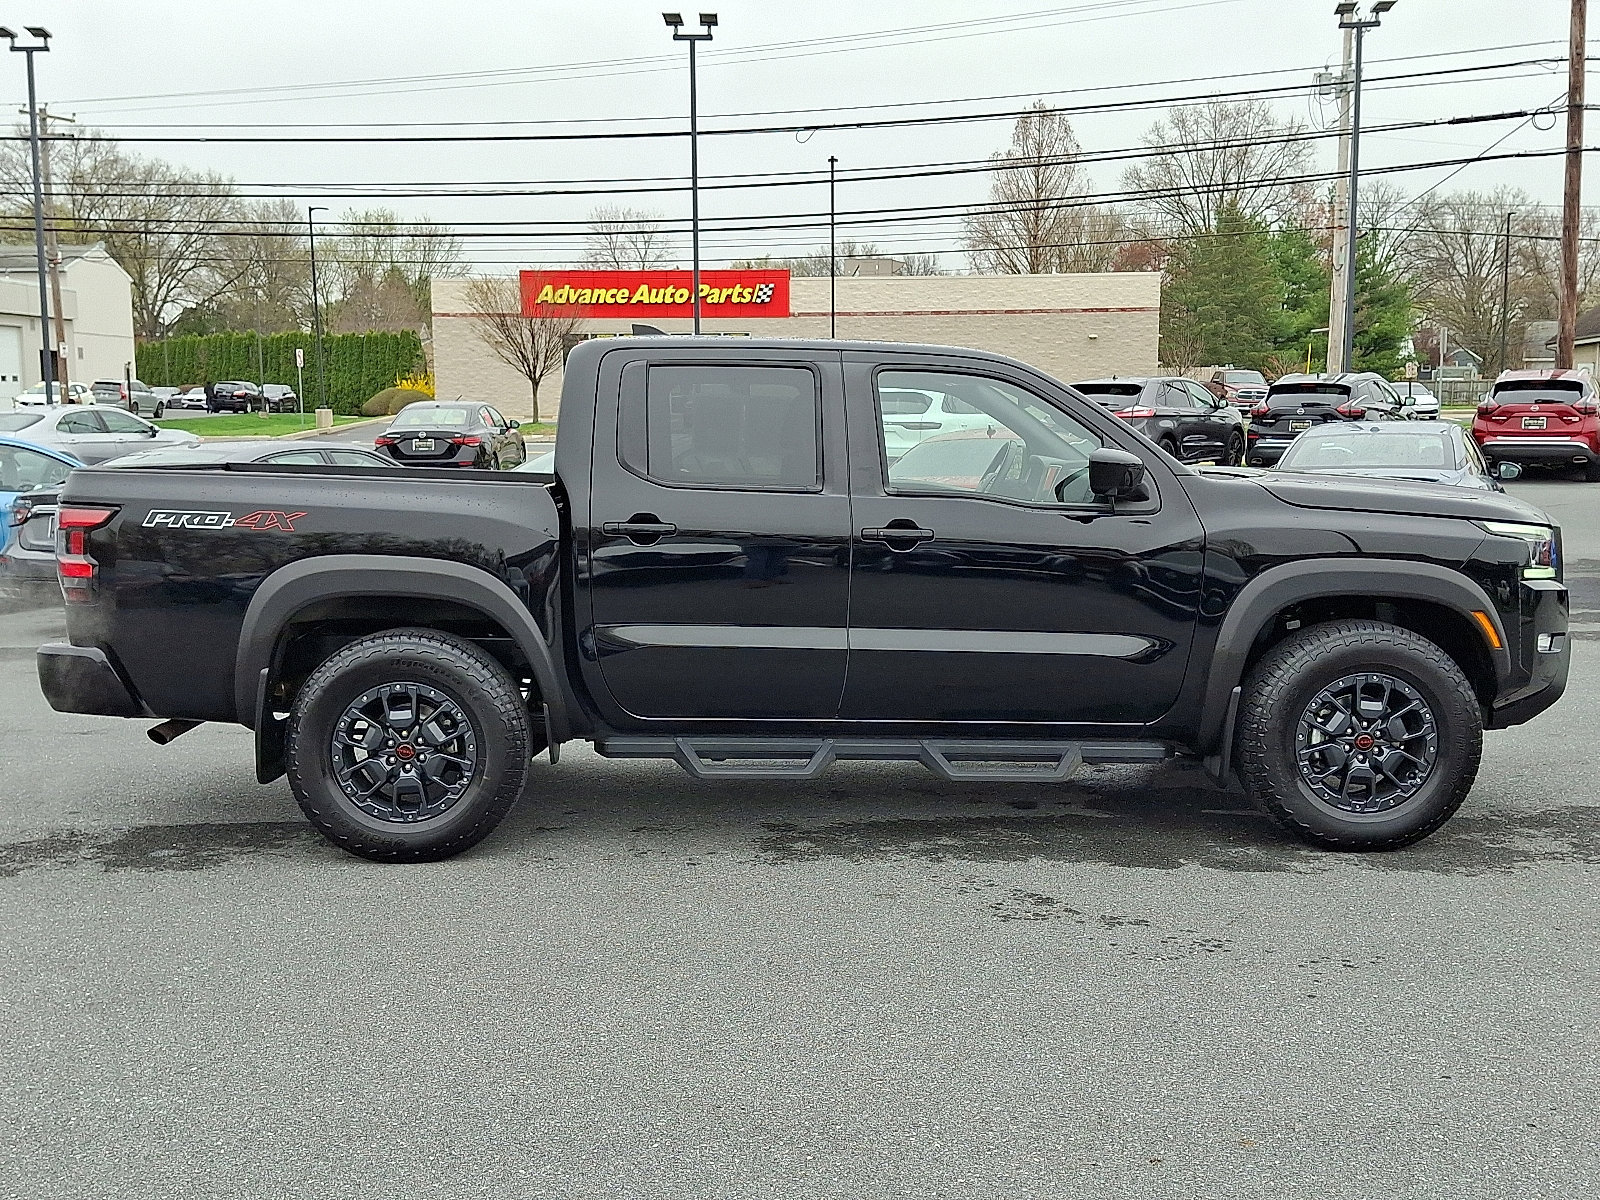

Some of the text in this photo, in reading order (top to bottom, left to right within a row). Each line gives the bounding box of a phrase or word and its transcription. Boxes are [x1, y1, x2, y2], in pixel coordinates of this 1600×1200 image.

[536, 283, 754, 304] Advance Auto Parts
